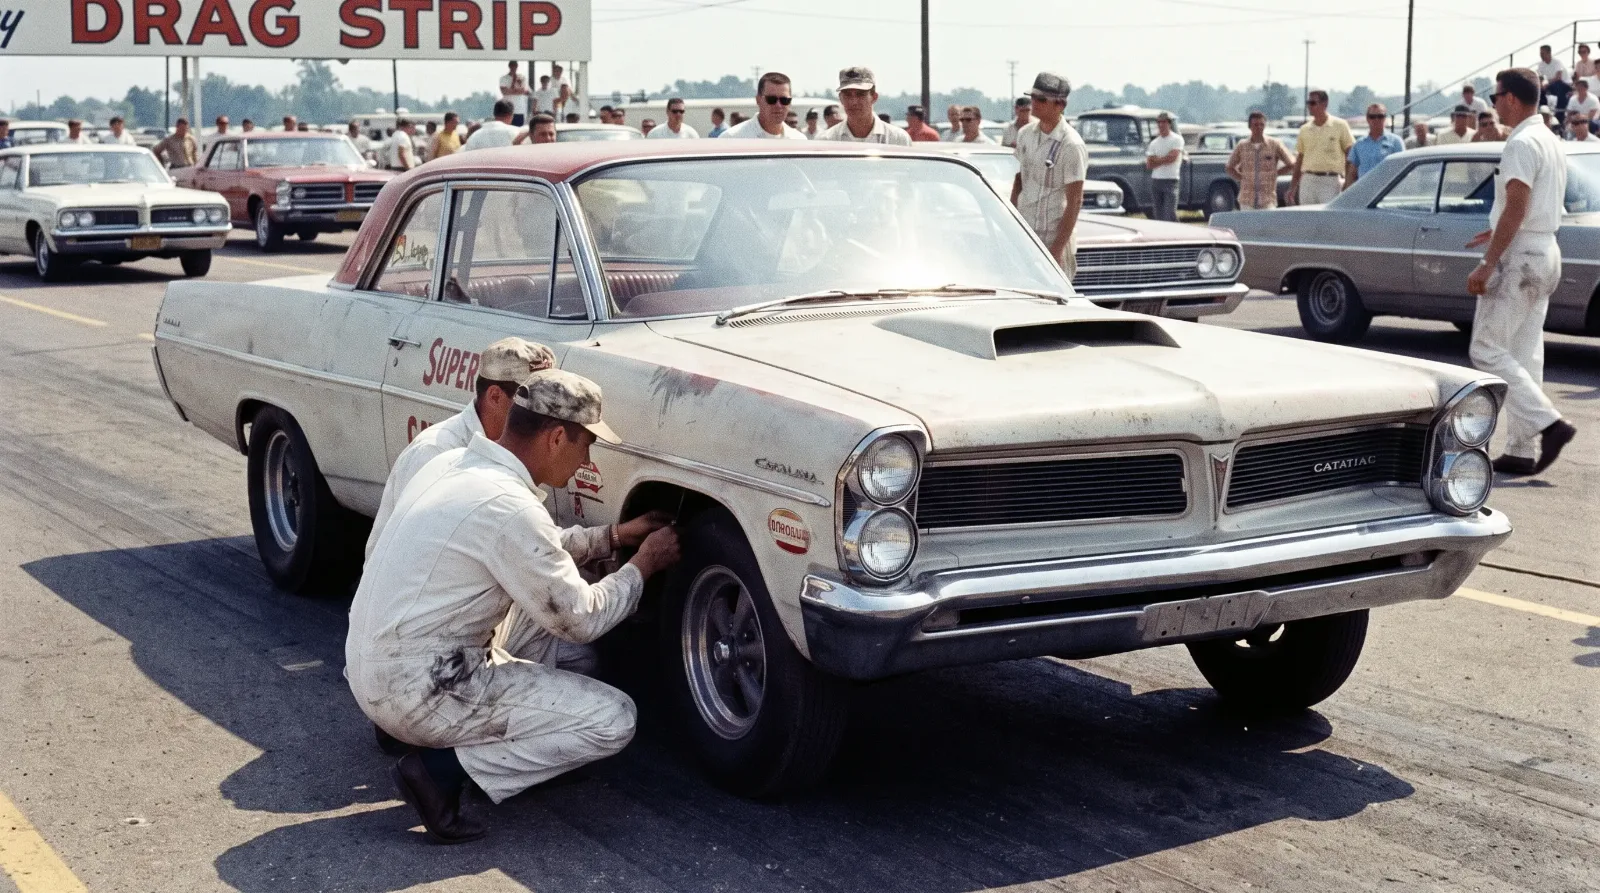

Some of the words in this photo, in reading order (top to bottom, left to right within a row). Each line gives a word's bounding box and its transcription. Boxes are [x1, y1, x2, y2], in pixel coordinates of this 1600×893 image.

[71, 0, 301, 48] DRAG
[339, 0, 562, 50] STRIP
[422, 337, 481, 393] SUPER
[1313, 455, 1377, 473] CATATIAC
